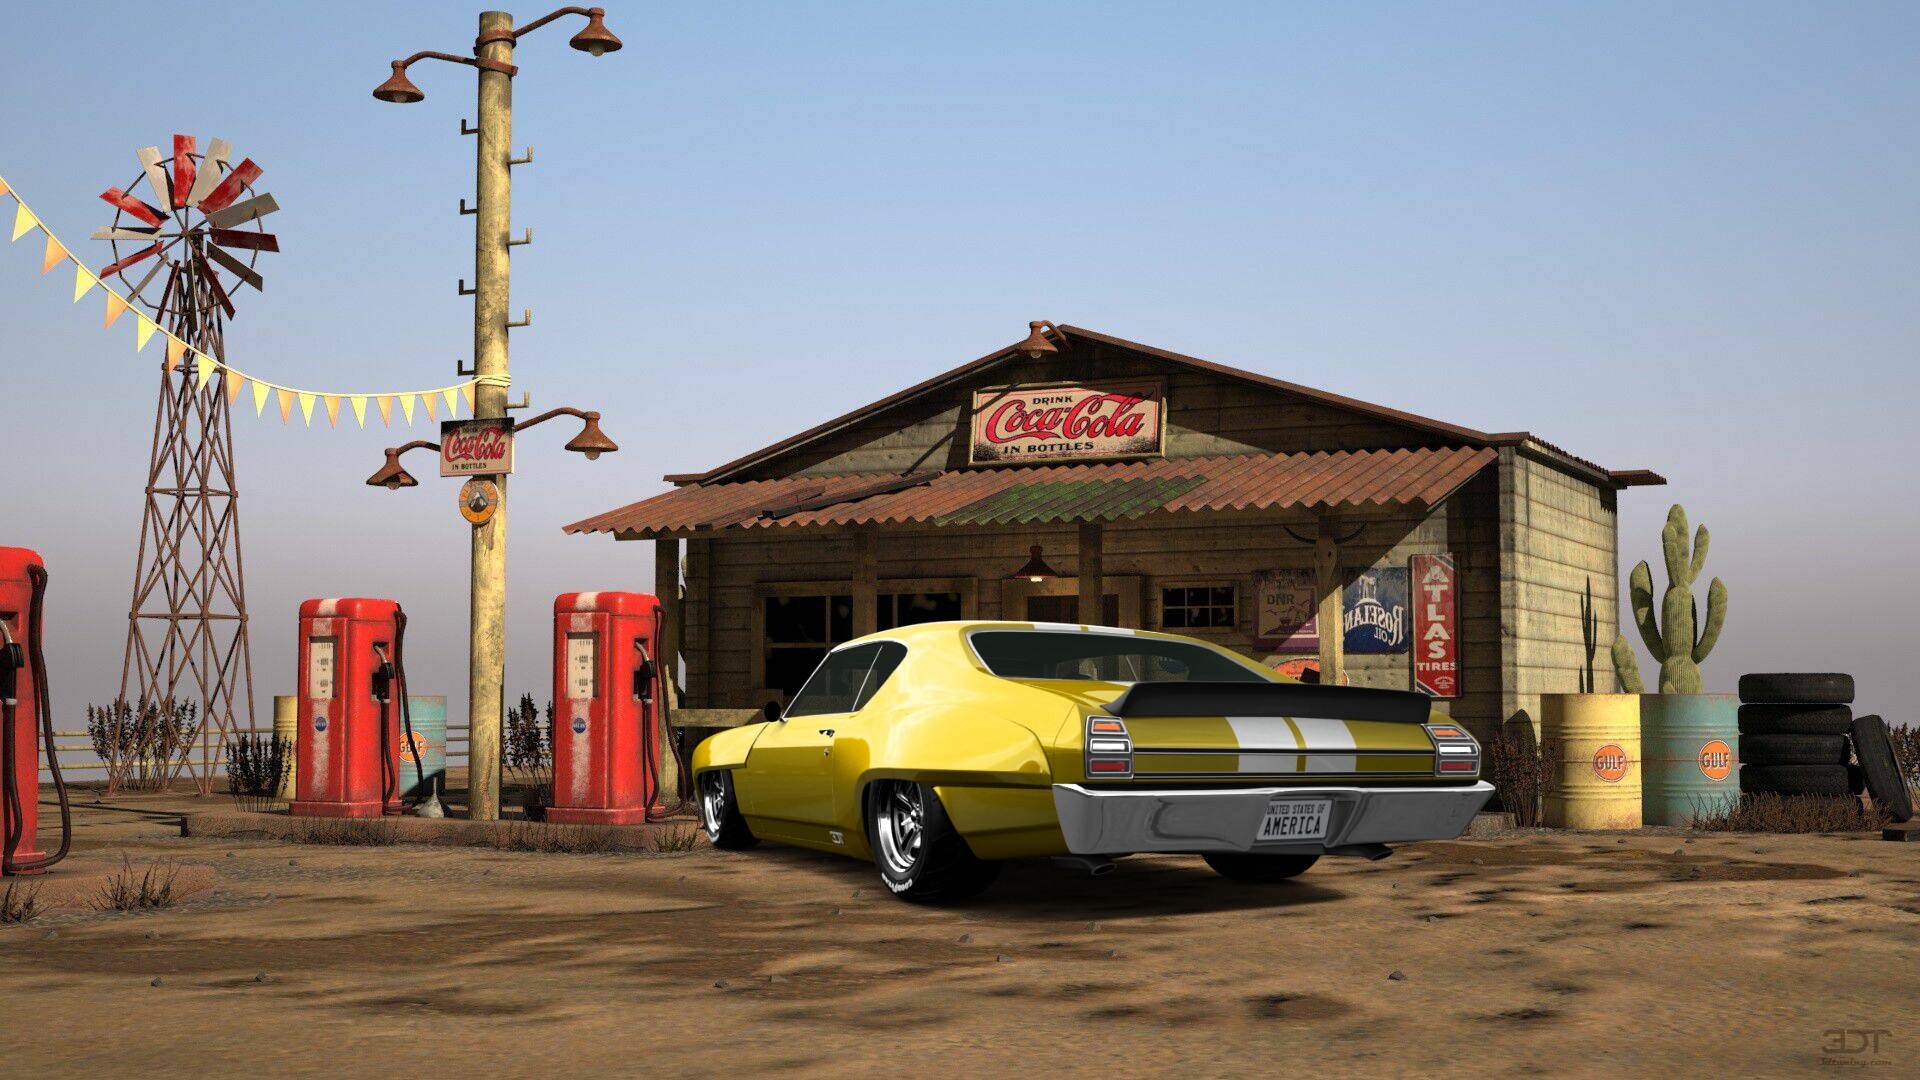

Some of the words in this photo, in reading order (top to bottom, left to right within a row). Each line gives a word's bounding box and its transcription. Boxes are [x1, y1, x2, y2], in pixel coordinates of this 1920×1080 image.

[1032, 395, 1073, 405] DRINK
[1003, 445, 1021, 454] IN
[1027, 441, 1094, 453] BOTTLES
[1421, 565, 1451, 660] ATLAS
[1417, 661, 1457, 671] TIRES
[400, 741, 425, 752] GUF
[1595, 755, 1625, 771] GULF
[1701, 752, 1729, 768] GULF
[1266, 804, 1290, 815] UNITED
[1292, 803, 1315, 815] STATES
[1317, 803, 1326, 814] OF
[1263, 815, 1321, 836] AMERICA
